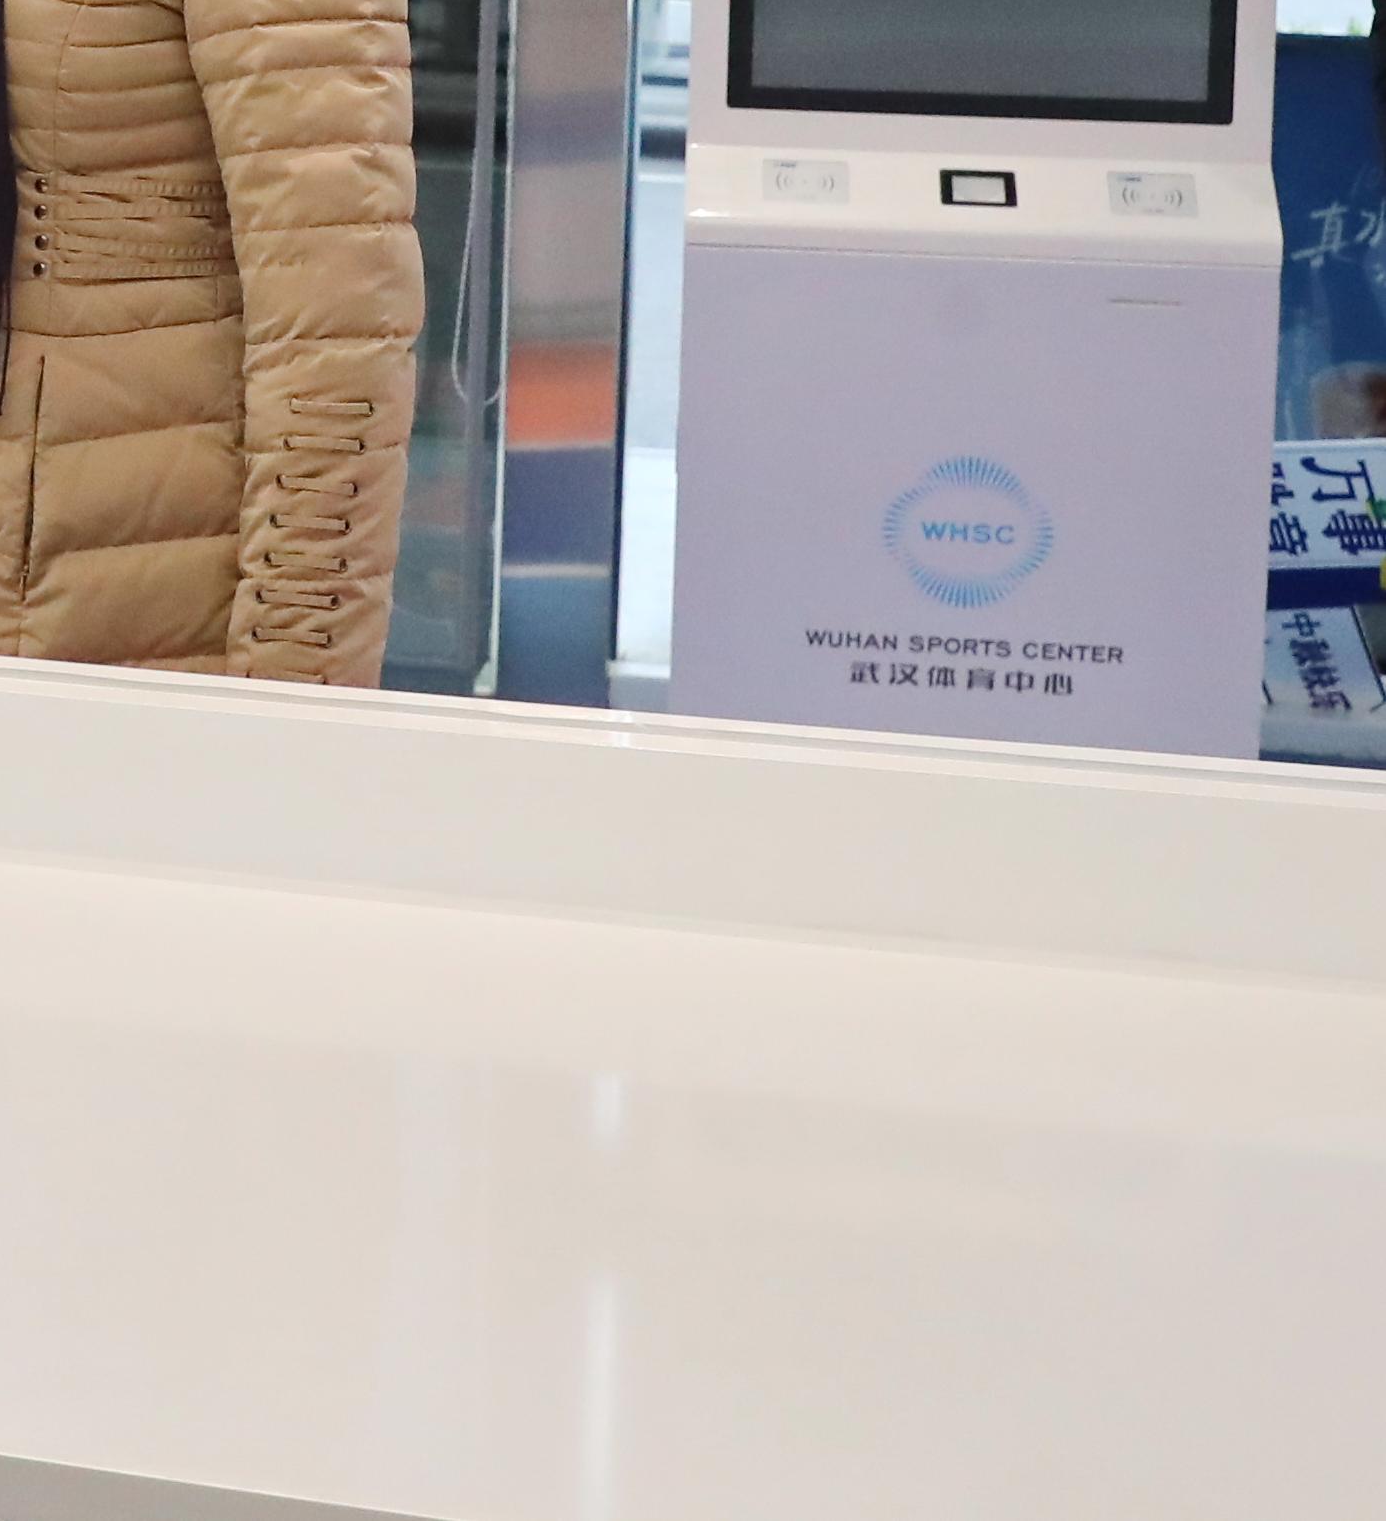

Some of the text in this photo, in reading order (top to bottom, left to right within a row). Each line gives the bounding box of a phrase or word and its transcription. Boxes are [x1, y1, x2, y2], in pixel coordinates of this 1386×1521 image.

[920, 521, 1016, 545] WHSC
[805, 629, 1125, 665] WUHAN SPORTS CENTER
[849, 660, 1074, 697] 武汉体育中心
